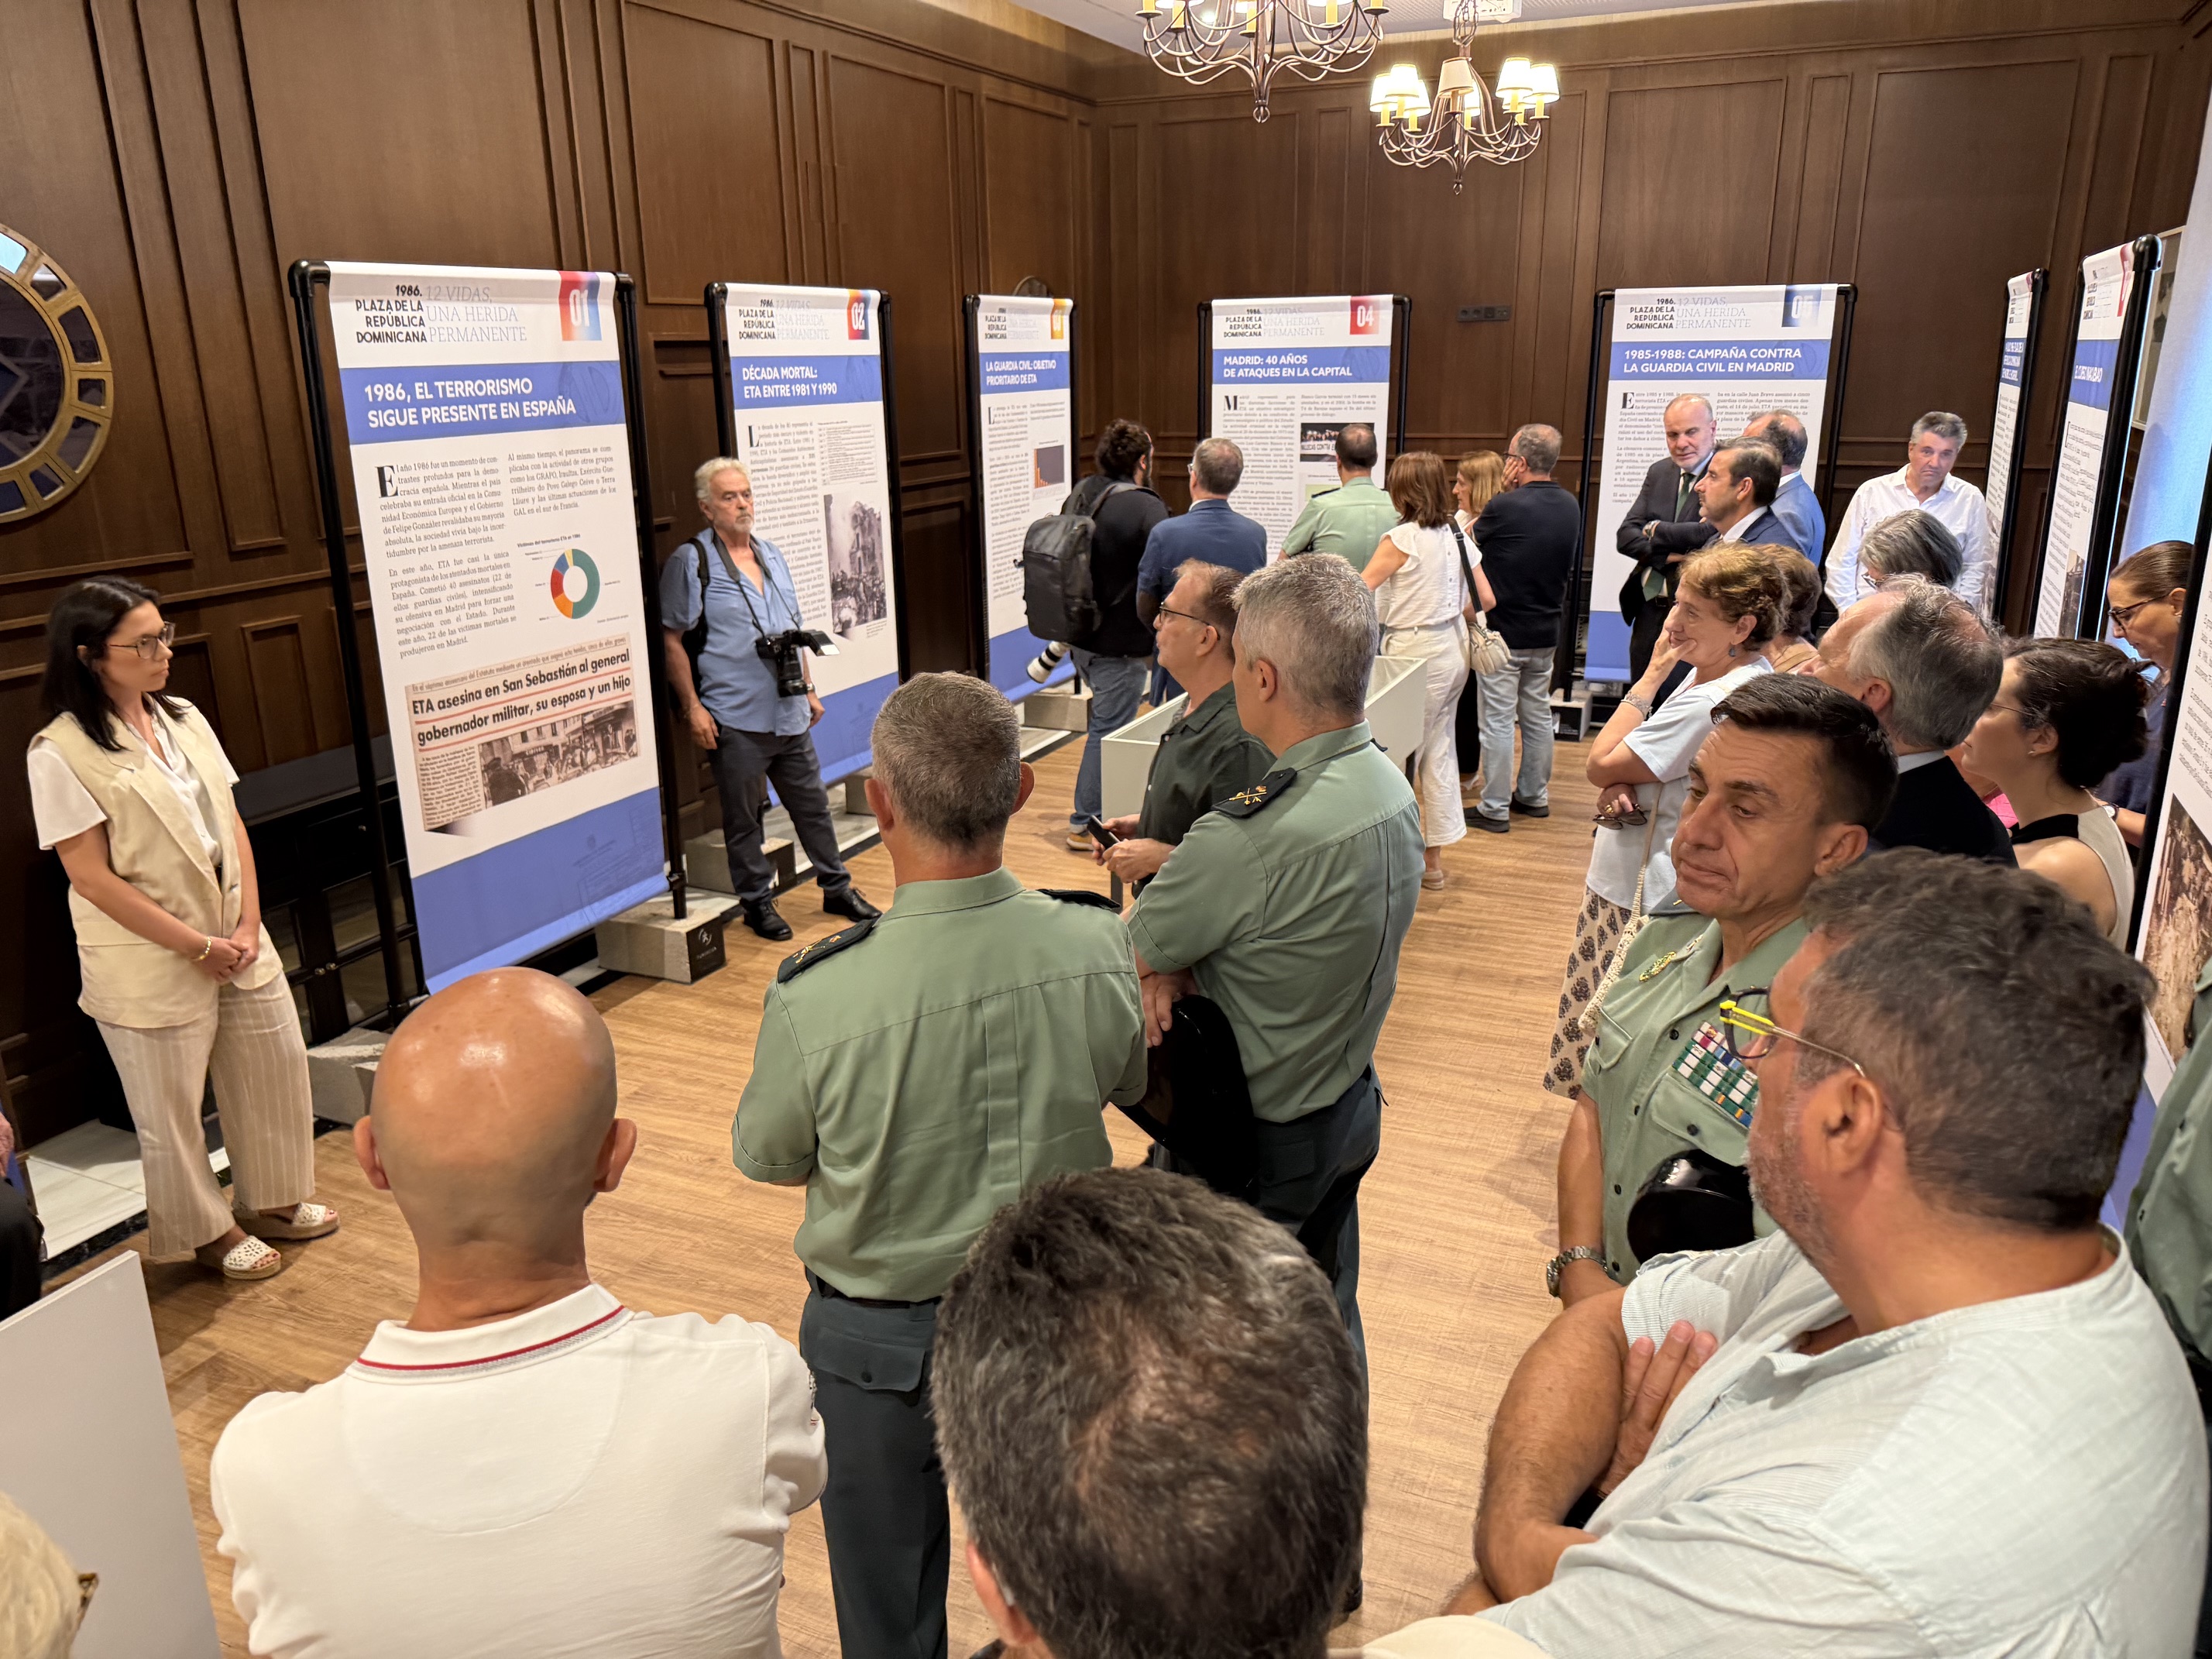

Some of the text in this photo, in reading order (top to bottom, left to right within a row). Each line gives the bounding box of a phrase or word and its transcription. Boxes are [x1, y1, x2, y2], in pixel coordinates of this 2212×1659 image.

[395, 284, 422, 297] 1986.
[426, 285, 493, 303] 12 VIDAS,
[355, 299, 424, 312] PLAZA DE LA
[569, 290, 590, 327] 01
[1678, 297, 1728, 307] 12 VIDAS,
[365, 311, 425, 328] REPÚBLICA
[425, 305, 519, 322] UNA HERIDA
[738, 309, 775, 318] PLAZA DE LA
[851, 302, 866, 331] 02
[1356, 305, 1375, 328] 04
[1633, 312, 1674, 321] REPÚBLICA
[1676, 307, 1746, 318] UNA HERIDA
[744, 316, 775, 328] REPÚBLICA
[1229, 321, 1262, 330] REPÚBLICA
[1263, 316, 1321, 327] UNA HERIDA
[1675, 318, 1751, 329] PERMANENTE
[356, 331, 428, 343] DOMINICANA
[428, 326, 527, 342] PERMANENTE
[739, 331, 776, 339] DOMINICANA
[1263, 327, 1325, 337] PERMANENTE
[1223, 352, 1307, 366] MADRID: 40 AÑOS
[1624, 346, 1802, 359] 1985-1988: CAMPAÑA CONTRA
[742, 364, 818, 380] DÉCADA MORTAL:
[986, 362, 994, 372] LA
[994, 361, 1018, 371] GUARDIA
[1223, 366, 1352, 379] DE ATAQUES EN LA CAPITAL
[1623, 362, 1795, 373] LA GUARDIA CIVIL EN MADRID
[986, 373, 1037, 386] PRIORITARIO DE ETA
[364, 377, 533, 403] 1986, EL TERRORISMO
[744, 382, 837, 398] ETA ENTRE 1981 Y 1990
[367, 395, 576, 428] SIGUE PRESENTE EN ESPAÑA
[400, 464, 412, 472] año
[413, 462, 429, 471] 1986
[430, 461, 440, 469] fue
[449, 458, 479, 467] momento
[397, 476, 421, 484] trastes
[423, 471, 454, 484] profundos
[456, 471, 472, 480] para
[473, 468, 480, 476] la
[399, 487, 420, 496] cracia
[452, 481, 479, 490] Mientras
[481, 479, 487, 487] el
[380, 500, 412, 511] celebraba
[423, 496, 447, 506] entrada
[447, 492, 466, 503] oficial
[381, 501, 503, 523] nidad Económica Europea y el Gobierno
[383, 526, 392, 535] de
[392, 524, 412, 534] Felipe
[441, 515, 473, 527] revalidaba
[481, 511, 505, 521] mayoría
[415, 534, 422, 542] la
[423, 529, 451, 541] sociedad
[467, 526, 482, 535] bajo
[386, 547, 416, 558] tidumbre
[417, 546, 429, 555] por
[438, 541, 463, 551] amenaza
[412, 698, 435, 715] ETA
[437, 689, 483, 711] asesina
[484, 685, 500, 698] en
[503, 679, 524, 693] San
[525, 662, 577, 687] Sebastián
[579, 658, 589, 673] al
[590, 648, 630, 673] general
[417, 675, 630, 747] gobernador militar, su esposa y un hijo
